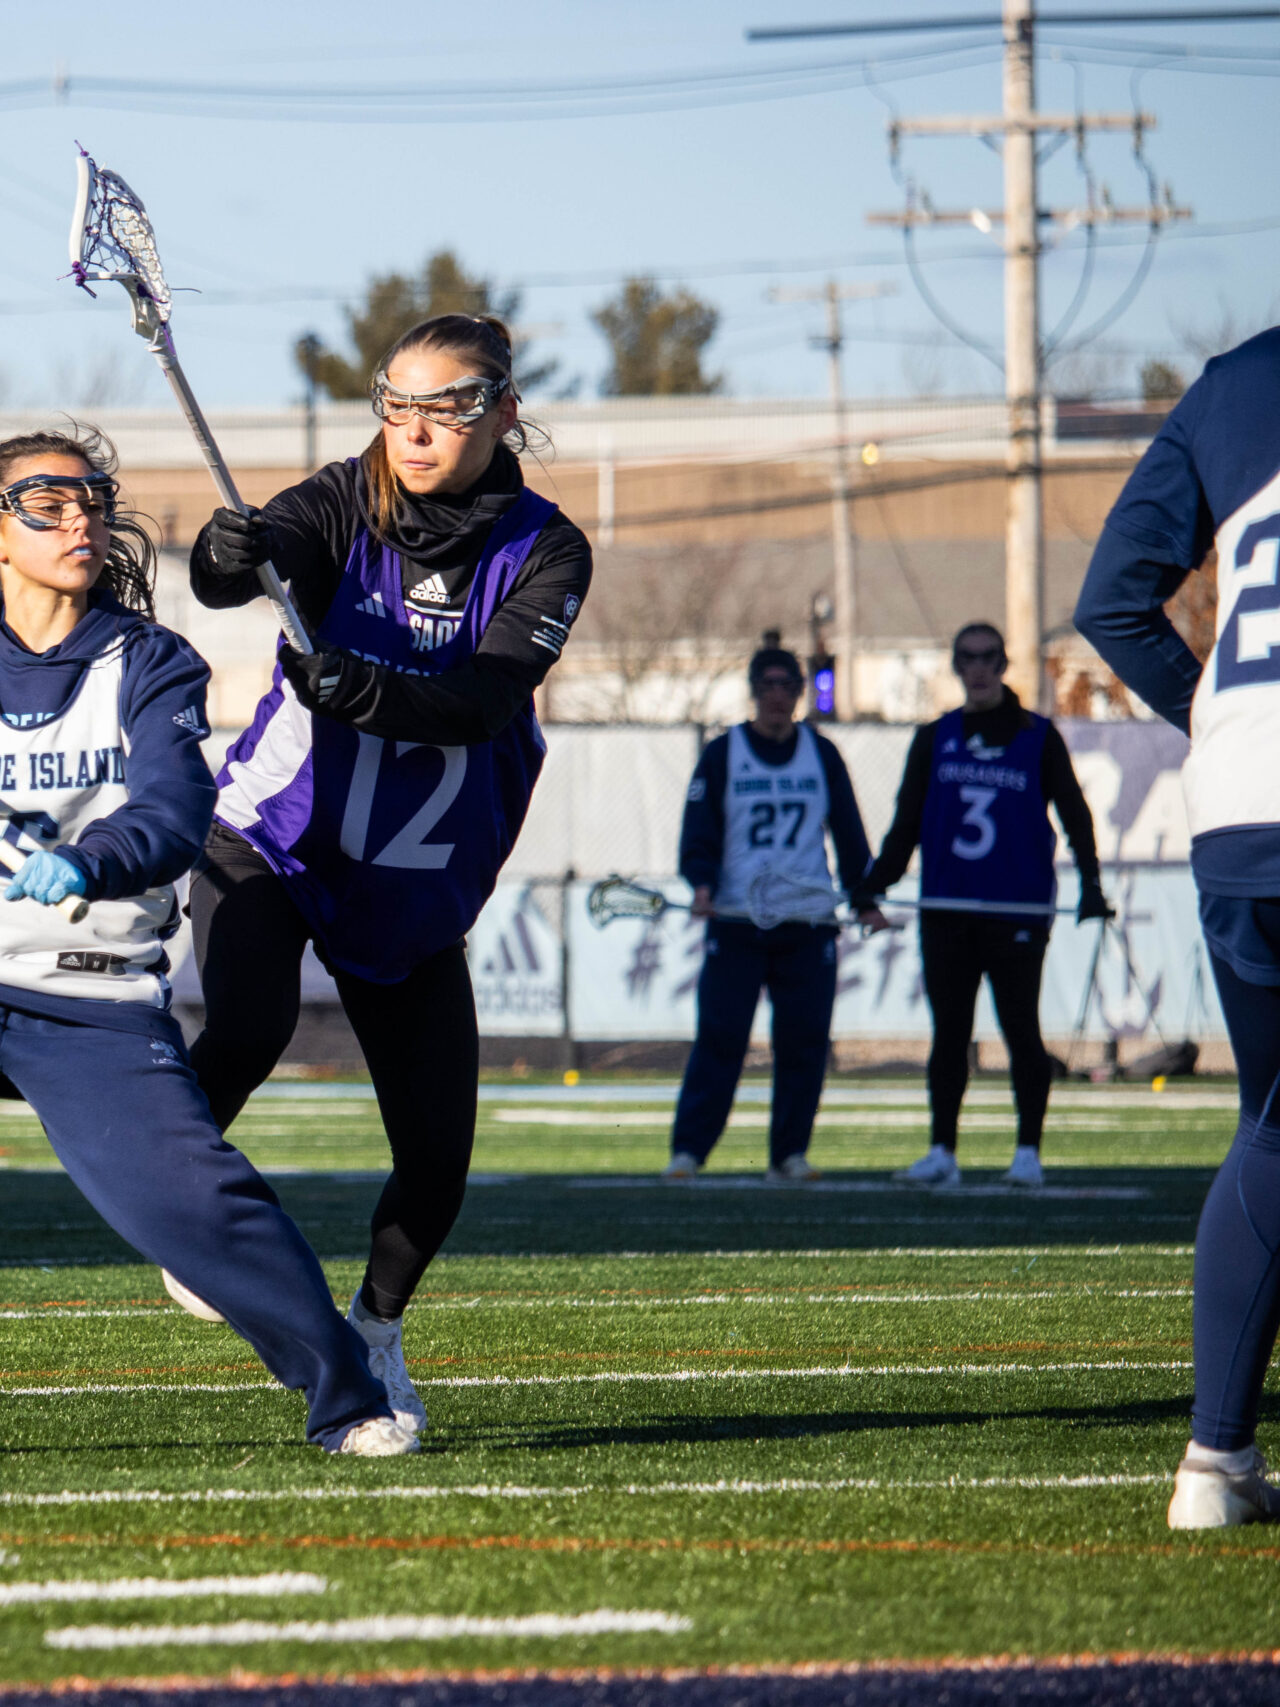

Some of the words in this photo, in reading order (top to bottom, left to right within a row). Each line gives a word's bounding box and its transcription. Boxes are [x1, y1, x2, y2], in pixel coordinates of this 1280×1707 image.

[409, 589, 451, 604] adidas
[409, 613, 461, 652] SAD
[340, 730, 468, 869] 12
[951, 784, 998, 860] 3
[750, 801, 806, 848] 27
